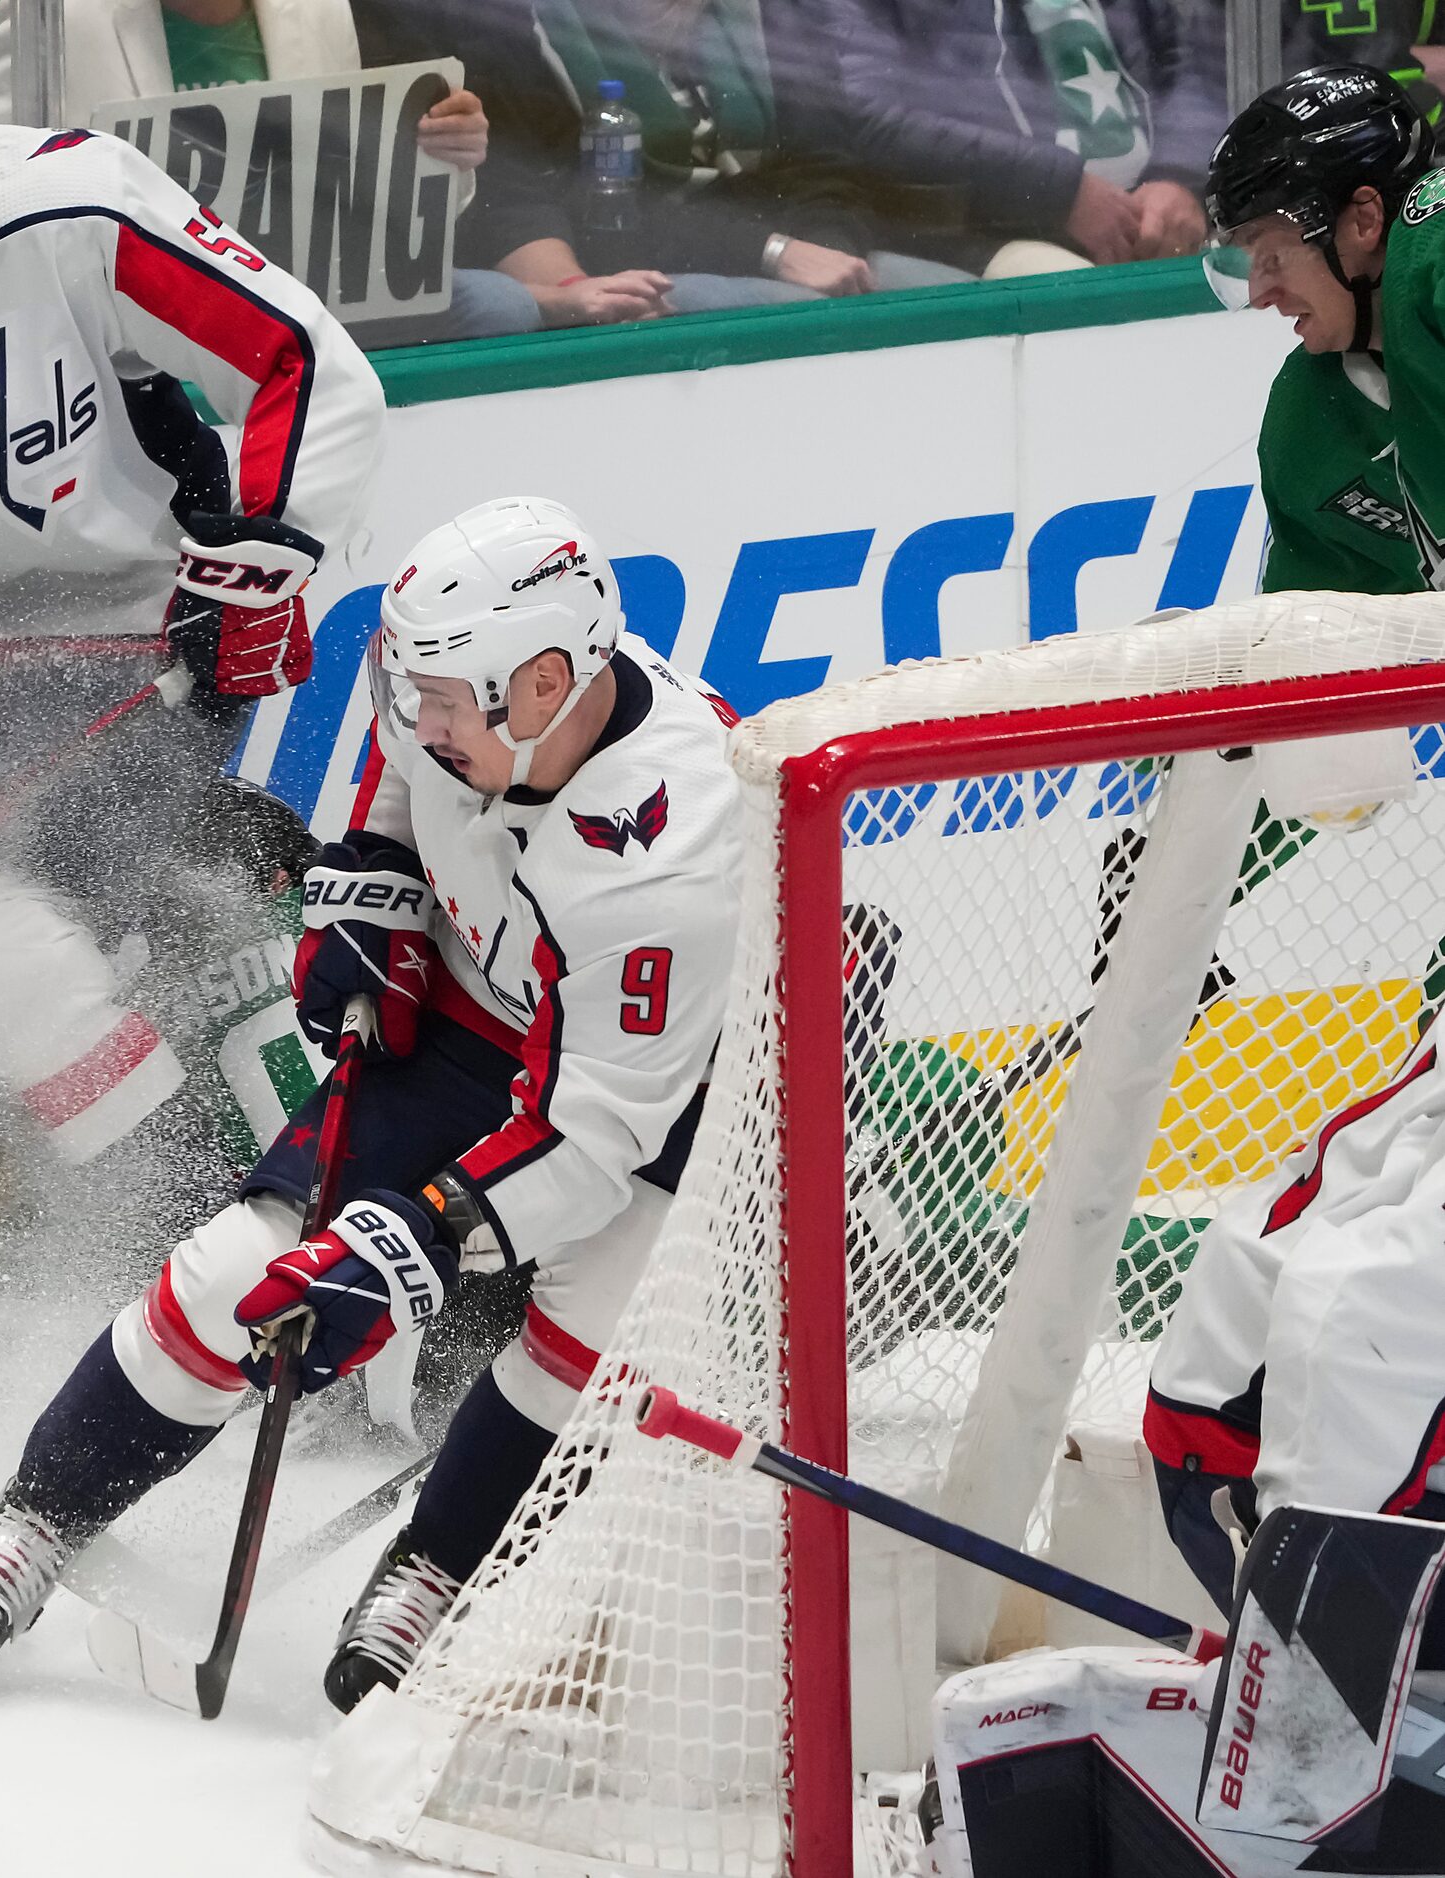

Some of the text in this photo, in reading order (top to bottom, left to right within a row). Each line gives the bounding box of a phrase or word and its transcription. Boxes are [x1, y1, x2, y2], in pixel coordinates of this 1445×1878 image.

[1347, 498, 1403, 531] 56
[393, 564, 418, 594] 9
[304, 880, 424, 915] AUER
[620, 946, 673, 1036] 9
[344, 1014, 358, 1029] 9
[345, 1209, 435, 1332] BAUER
[978, 1703, 1051, 1729] MACH
[1220, 1641, 1271, 1811] BAUER
